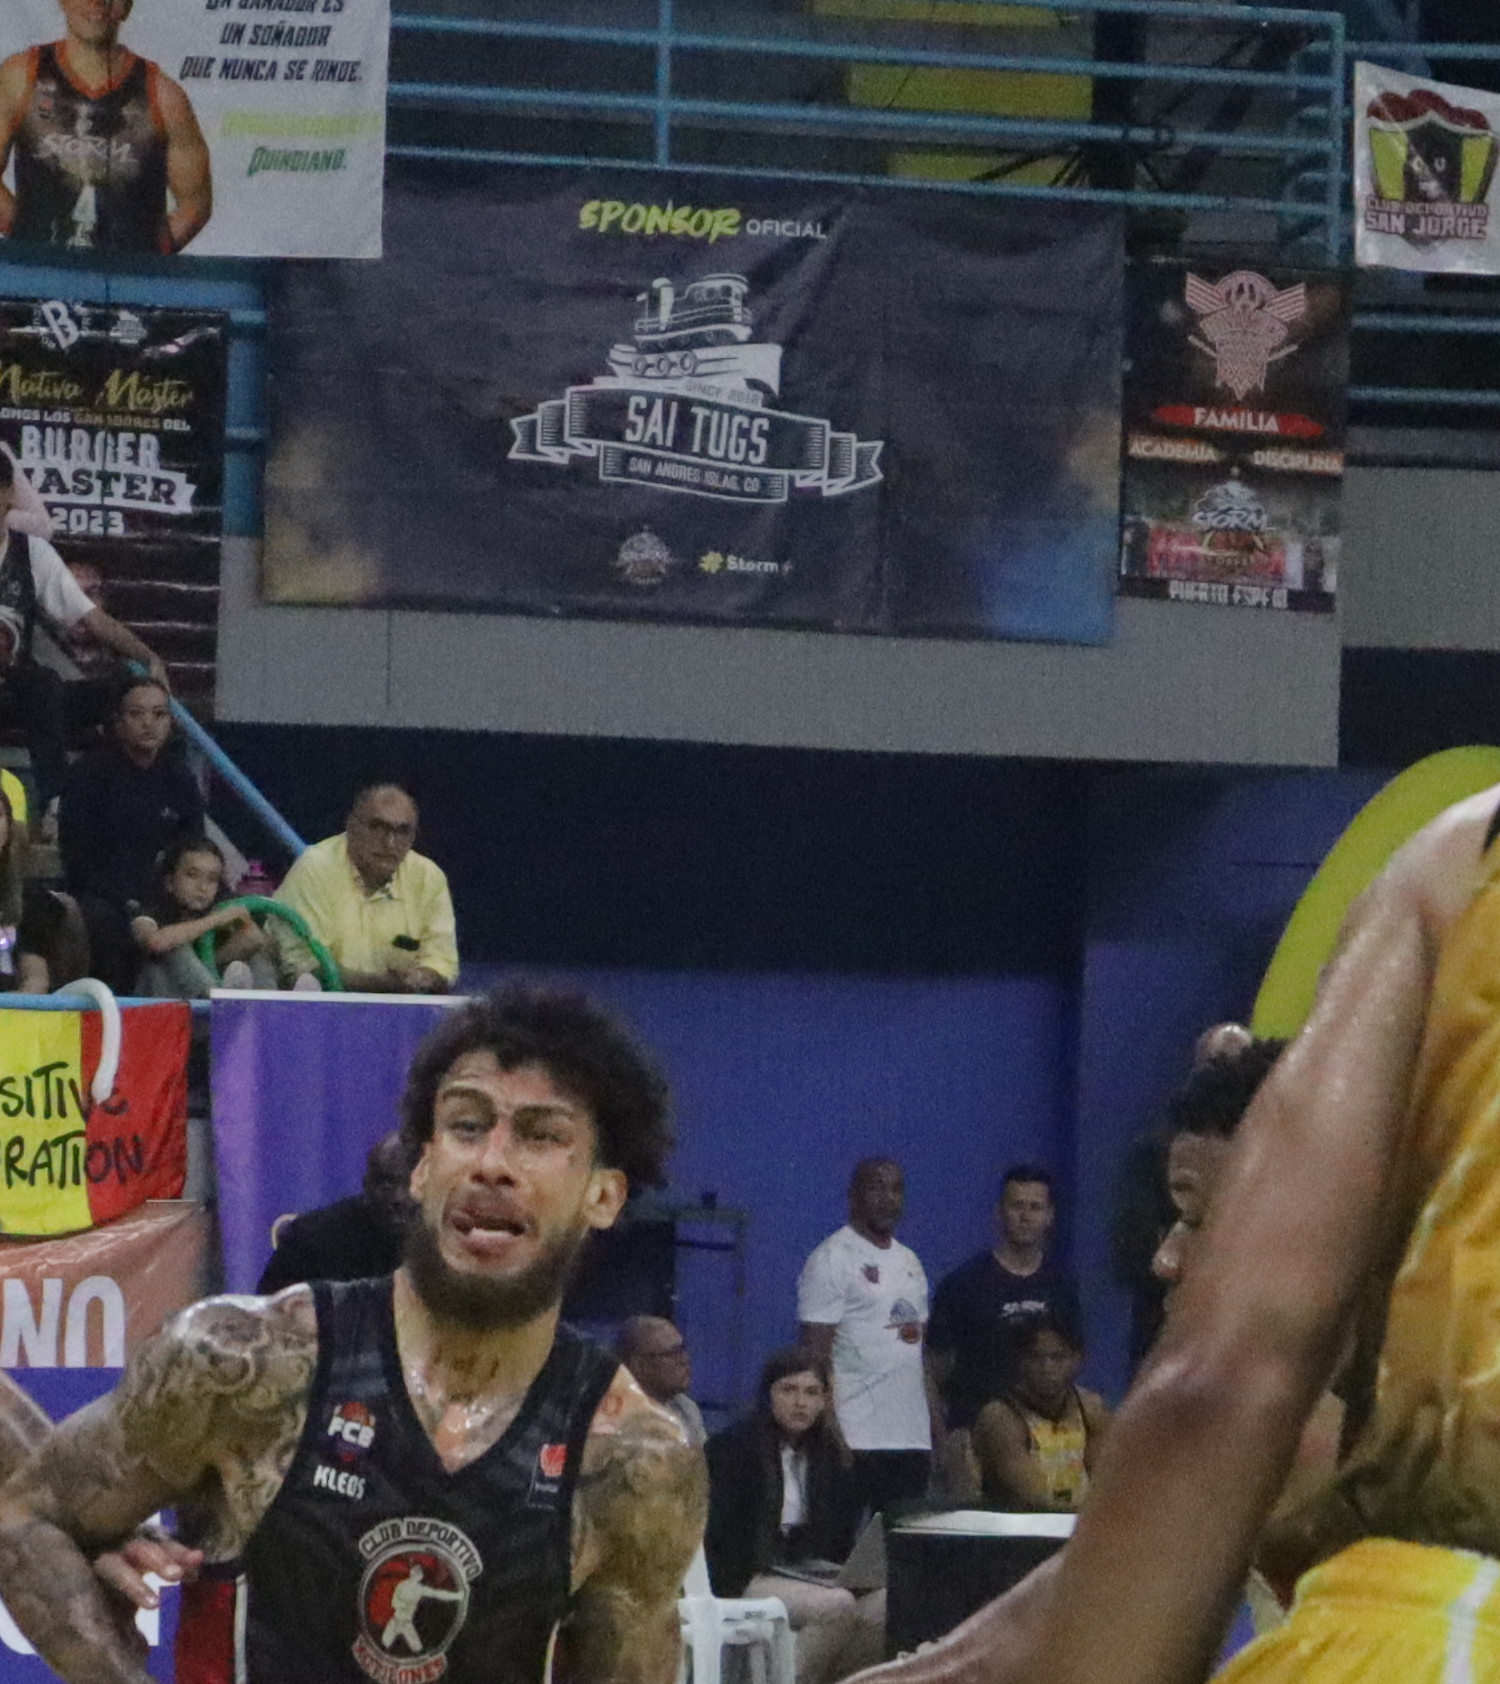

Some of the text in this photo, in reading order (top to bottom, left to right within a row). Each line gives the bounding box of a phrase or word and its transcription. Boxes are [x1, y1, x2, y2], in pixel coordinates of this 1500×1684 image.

[220, 21, 331, 47] UN SOÑADOR
[180, 56, 363, 82] QUE NUNCA SE RINDE.
[579, 201, 827, 242] SPONSOR OFICIAL
[1366, 211, 1487, 240] SAN JORGE
[43, 409, 71, 422] LOS
[163, 419, 191, 431] DEL
[625, 395, 771, 465] SAI TUGS
[1193, 407, 1280, 432] FAMILIA
[51, 506, 125, 534] 2023
[327, 1416, 376, 1449] FCB
[313, 1464, 367, 1500] KLEOS
[360, 1520, 482, 1580] CLUB DEPORTIVO
